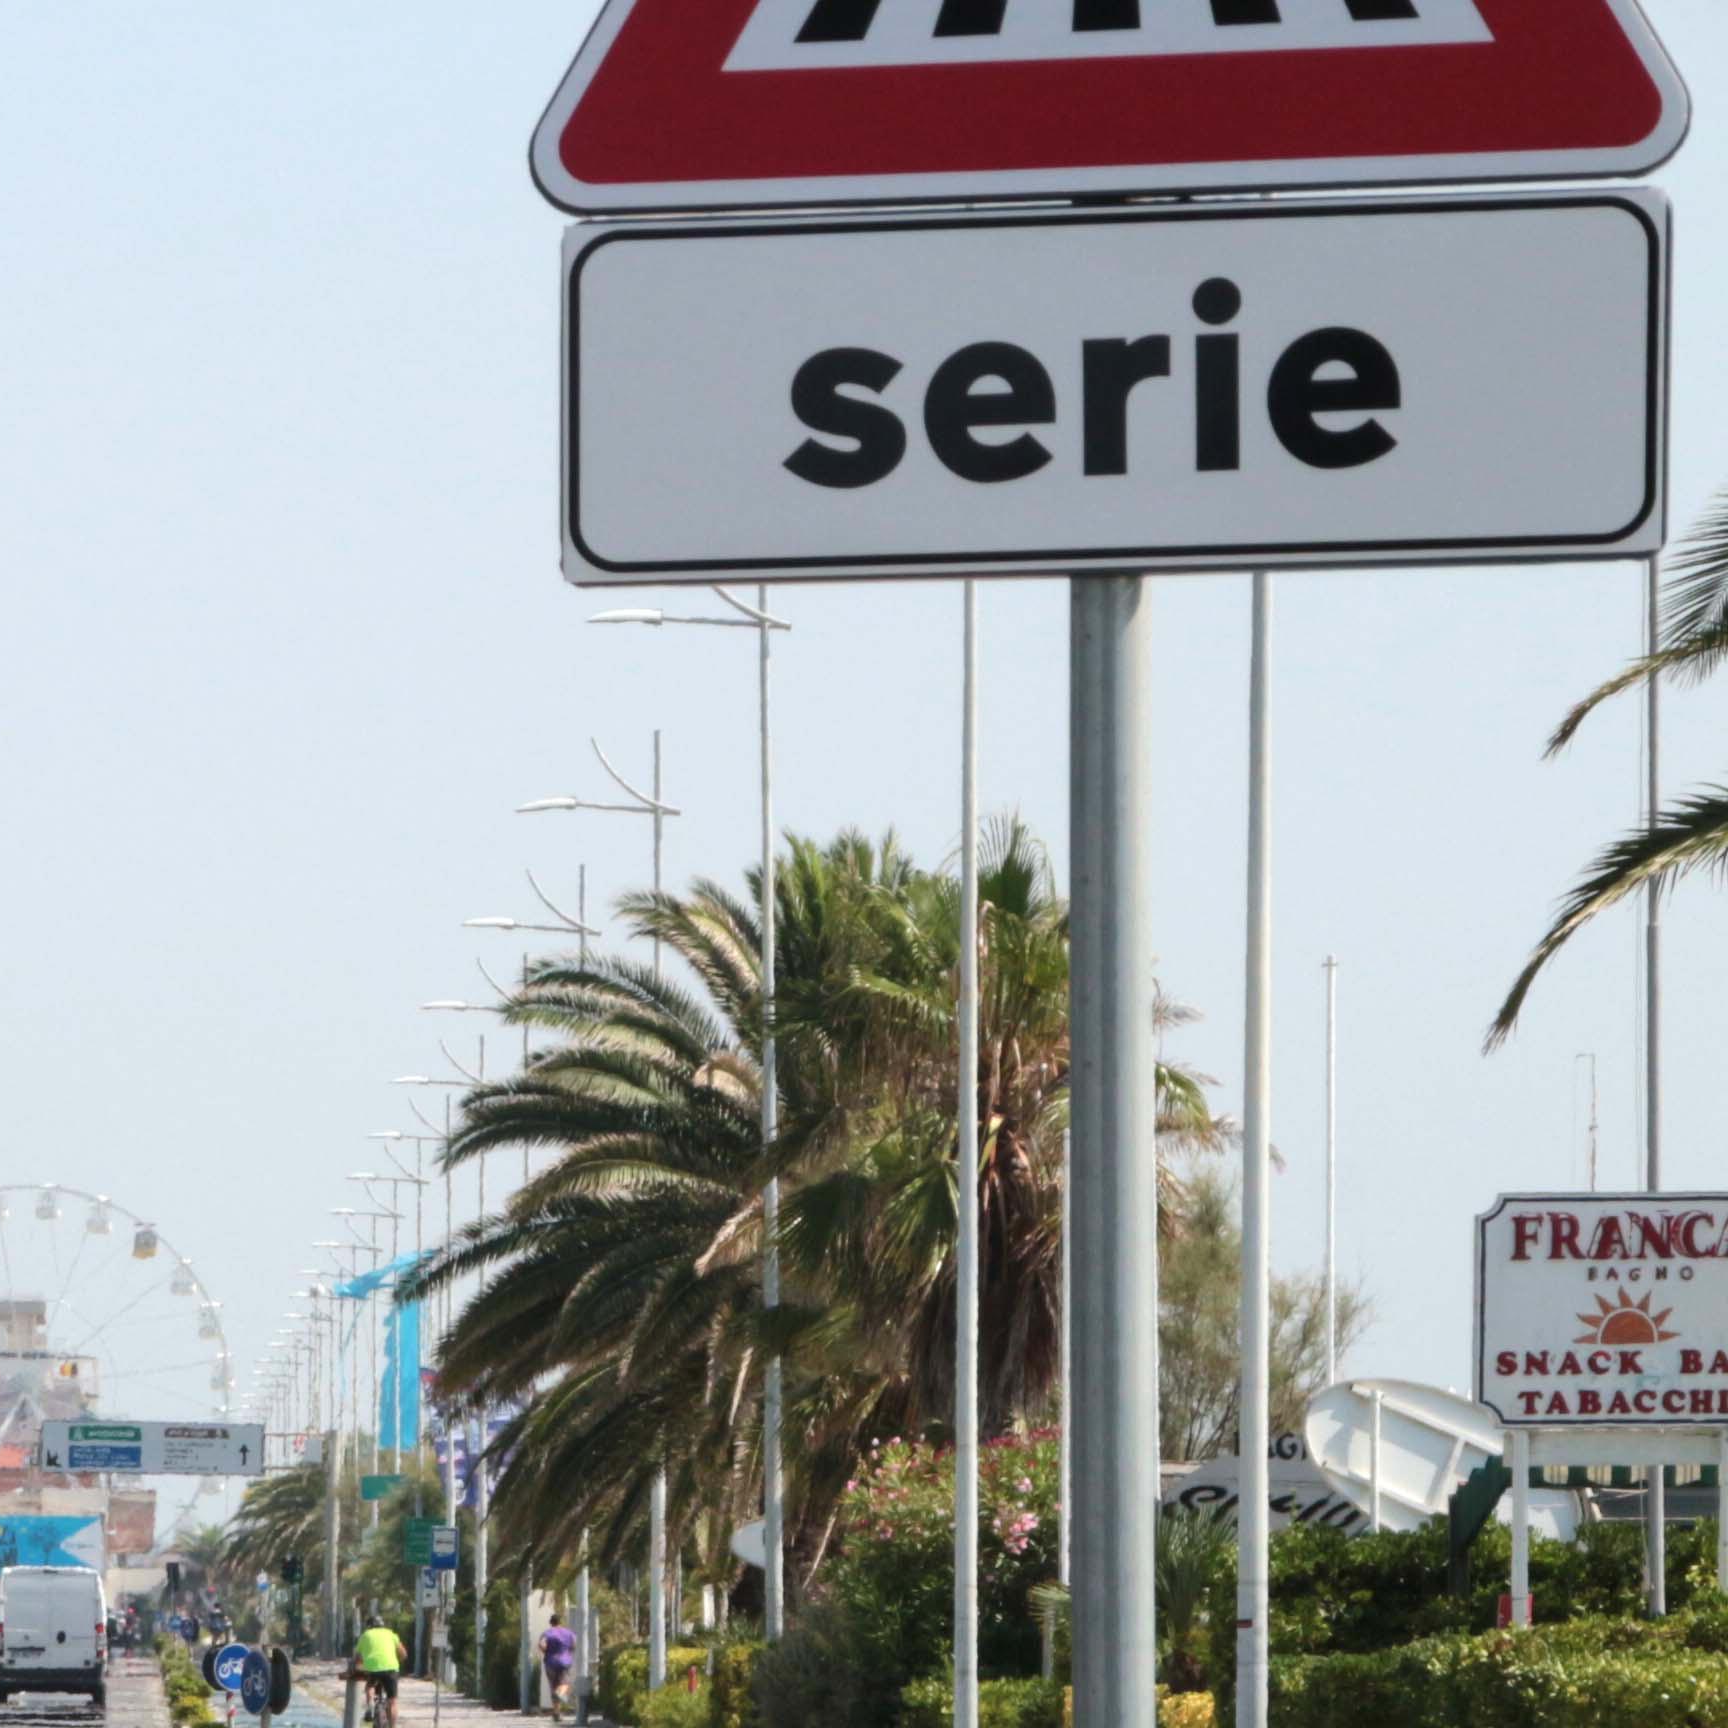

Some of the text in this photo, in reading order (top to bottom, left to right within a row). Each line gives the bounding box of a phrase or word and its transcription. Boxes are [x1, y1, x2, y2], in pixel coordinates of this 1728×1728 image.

[782, 277, 1402, 490] serie
[1587, 1265, 1695, 1281] BAGNO
[1496, 1350, 1644, 1376] SNACK
[1518, 1389, 1728, 1415] TABACCHI
